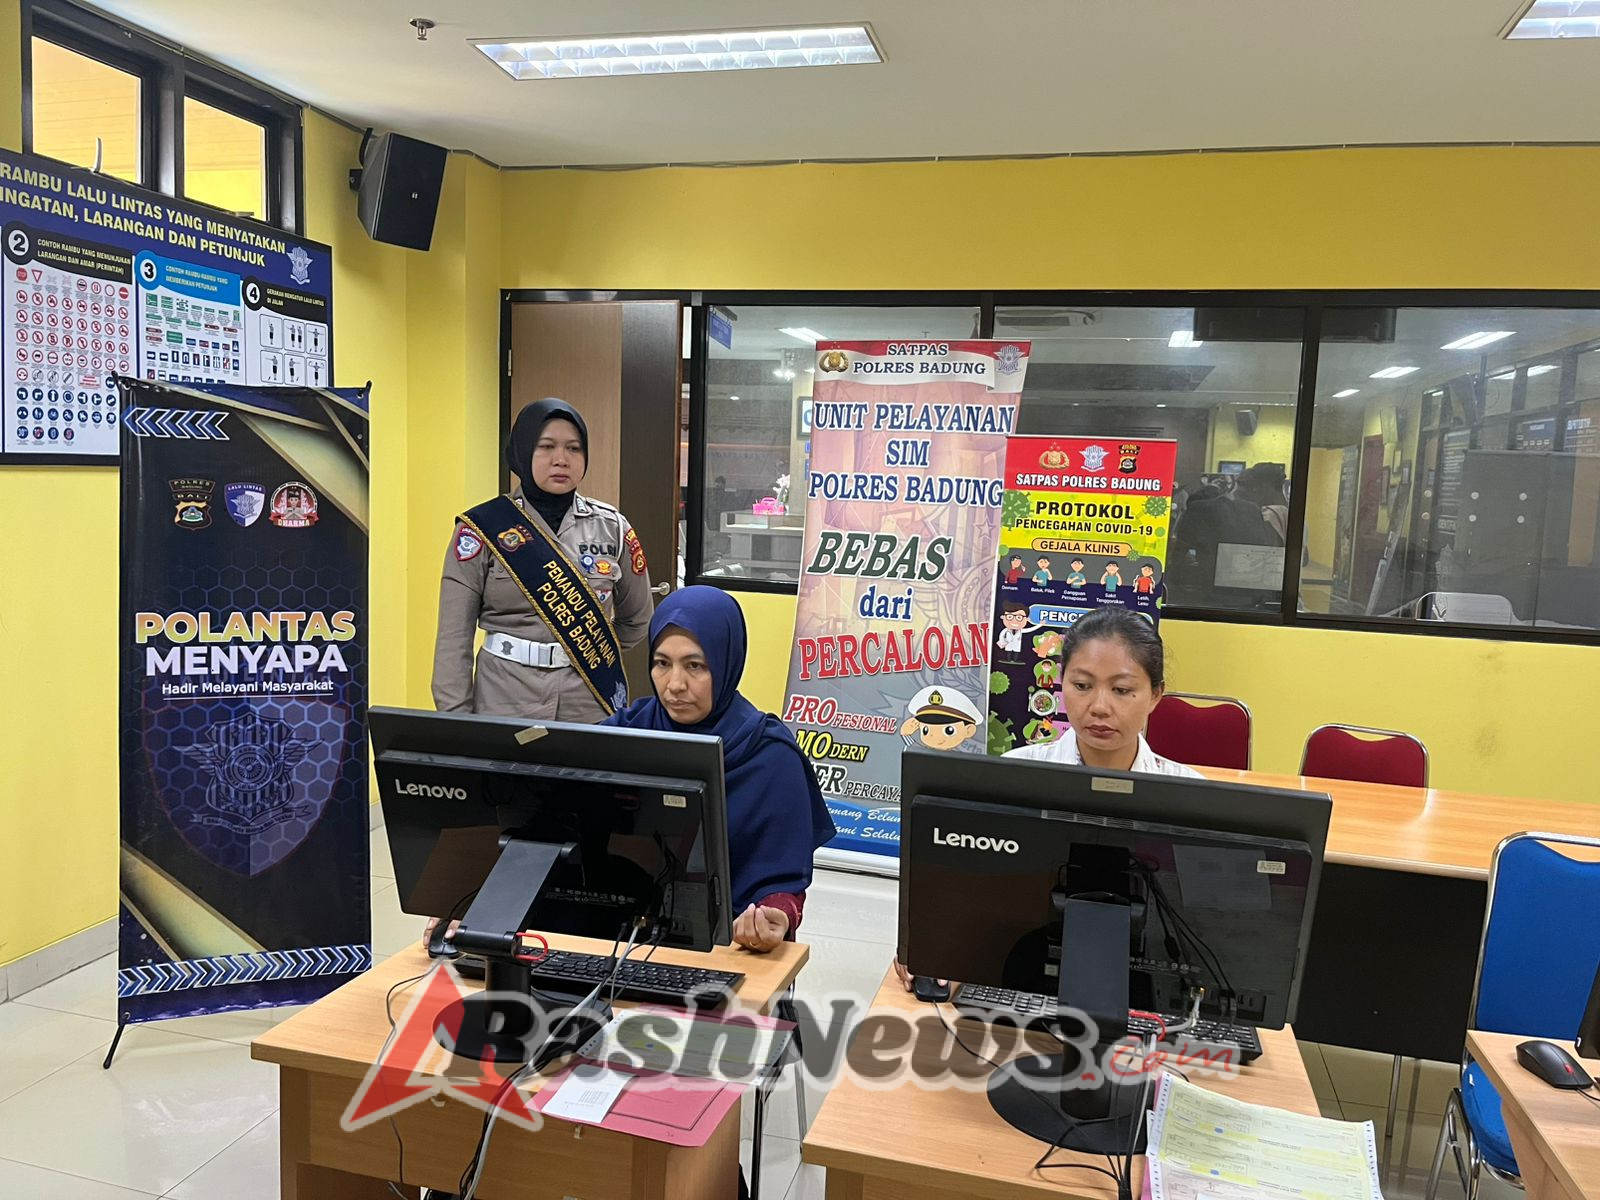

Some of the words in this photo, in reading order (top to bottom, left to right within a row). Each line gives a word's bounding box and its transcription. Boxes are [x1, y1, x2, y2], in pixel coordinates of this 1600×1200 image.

[0, 162, 62, 193] RAMBU
[67, 180, 107, 204] LALU
[111, 193, 162, 220] LINTAS
[166, 208, 203, 231] YANG
[206, 221, 286, 254] MENYATAKAN
[13, 233, 26, 252] 2
[37, 238, 61, 250] CONTOH
[61, 243, 81, 254] RAMBU
[81, 247, 96, 257] YANG
[83, 208, 165, 241] LARANGAN
[168, 230, 197, 249] DAN
[200, 239, 266, 267] PETUNJUK
[37, 250, 67, 262] LARANGAN
[67, 256, 79, 265] DAN
[79, 259, 95, 268] AMAR
[144, 262, 155, 279] 3
[249, 286, 258, 300] 4
[887, 343, 949, 356] SATPAS
[853, 362, 914, 374] POLRES
[919, 362, 987, 375] BADUNG
[814, 402, 868, 429] UNIT
[874, 403, 1016, 433] PELAYANAN
[885, 439, 931, 467] SIM
[808, 472, 899, 501] POLRES
[904, 476, 1003, 506] BADUNG
[1015, 473, 1059, 487] SATPAS
[1061, 475, 1107, 489] POLRES
[1110, 477, 1161, 491] BADUNG
[1035, 501, 1135, 520] PROTOKOL
[277, 518, 311, 527] DHARMA
[1015, 518, 1092, 532] PENCEGAHAN
[1095, 522, 1154, 536] COVID-19
[807, 531, 953, 582] BEBAS
[1040, 540, 1081, 552] GEJALA
[1084, 543, 1121, 555] KLINIS
[859, 584, 913, 620] dari
[543, 559, 588, 612] PEMANDU
[580, 609, 617, 668] PELAYANAN
[135, 611, 357, 644] POLANTAS
[537, 582, 576, 627] POLRES
[568, 625, 601, 670] BADUNG
[145, 644, 348, 677] MENYAPA
[798, 622, 990, 680] PERCALOAN
[162, 682, 199, 695] Hadir
[202, 680, 258, 695] Melayani
[262, 679, 334, 693] Masyarakat
[394, 778, 468, 801] Lenovo
[834, 824, 857, 835] ami
[932, 827, 1020, 854] Lenovo
